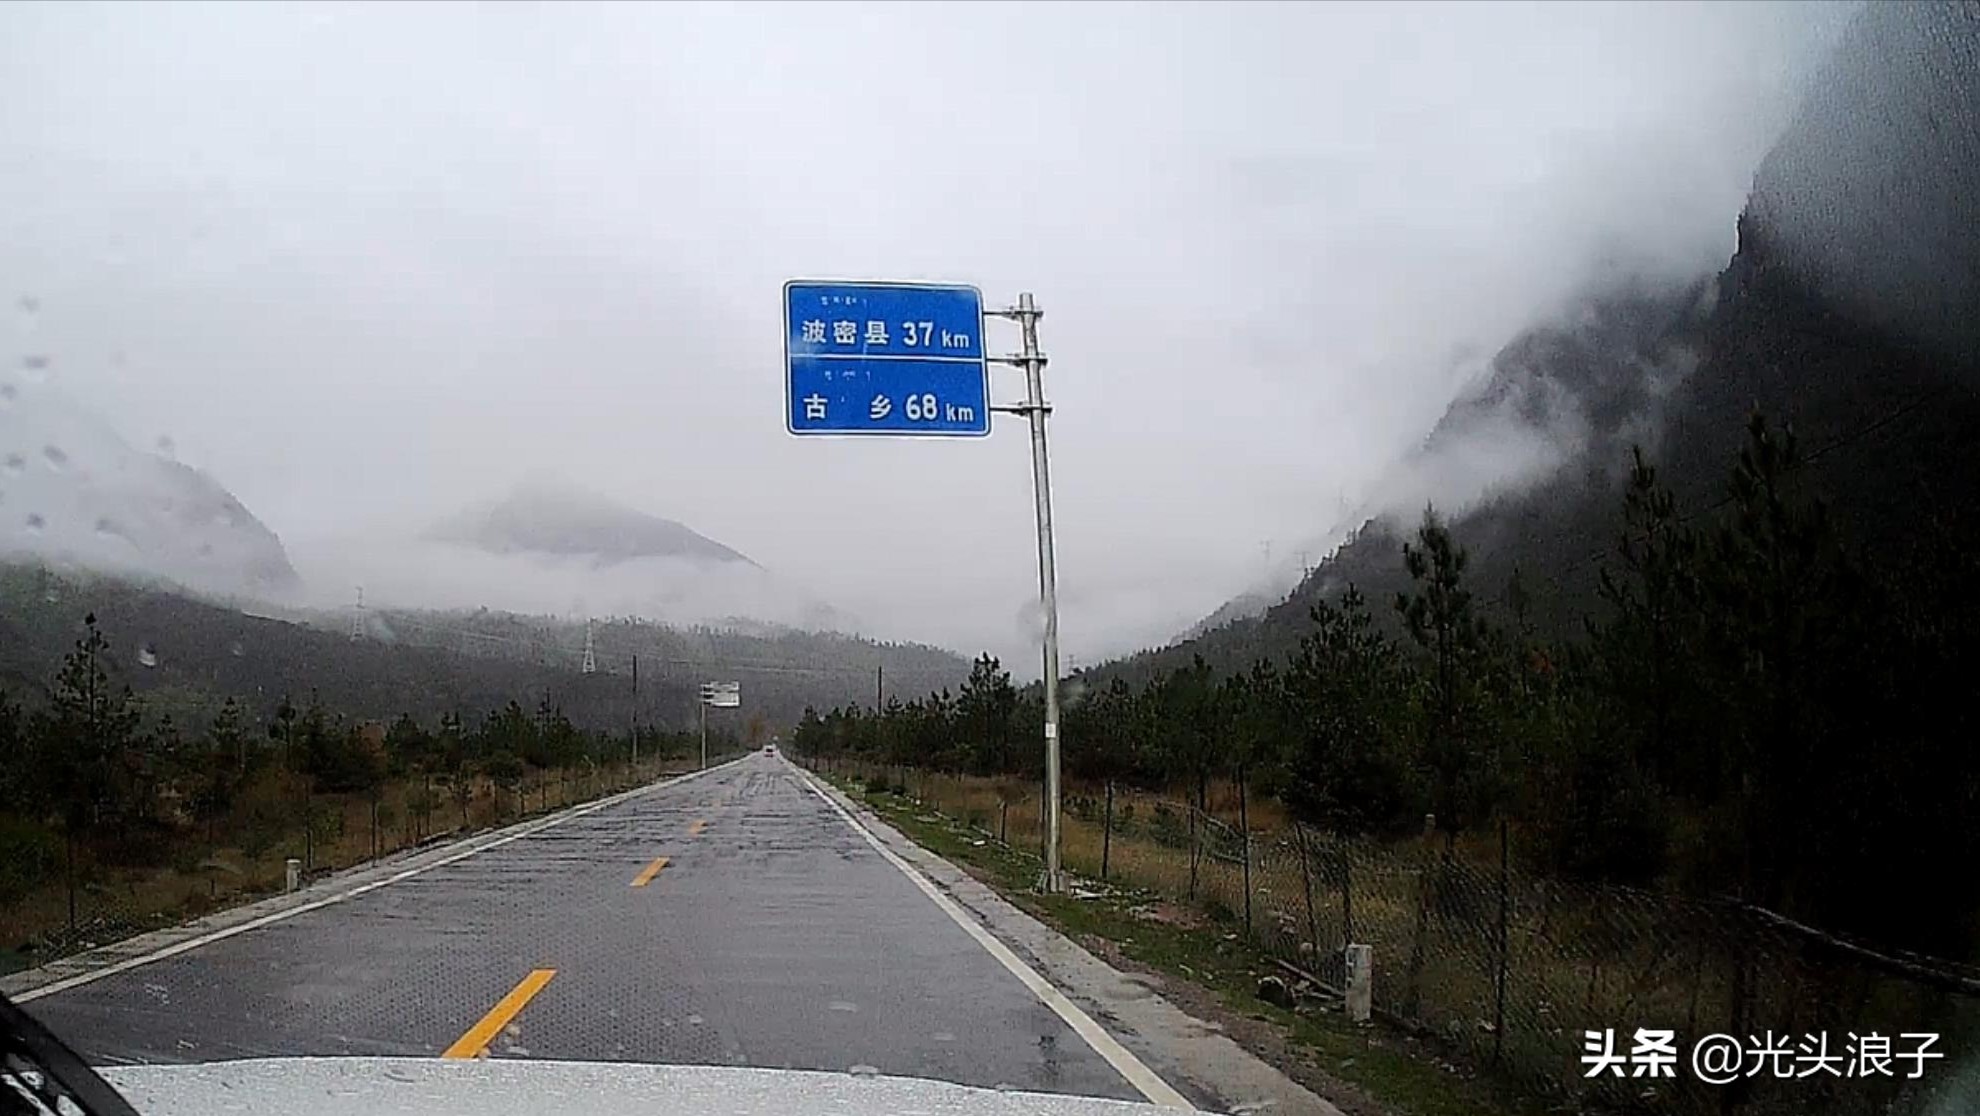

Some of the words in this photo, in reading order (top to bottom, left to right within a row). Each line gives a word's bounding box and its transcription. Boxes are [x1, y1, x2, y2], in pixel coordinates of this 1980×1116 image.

[801, 319, 890, 346] 波密县
[902, 321, 933, 347] 37
[941, 328, 970, 349] km
[905, 393, 938, 421] 68
[946, 402, 974, 423] km
